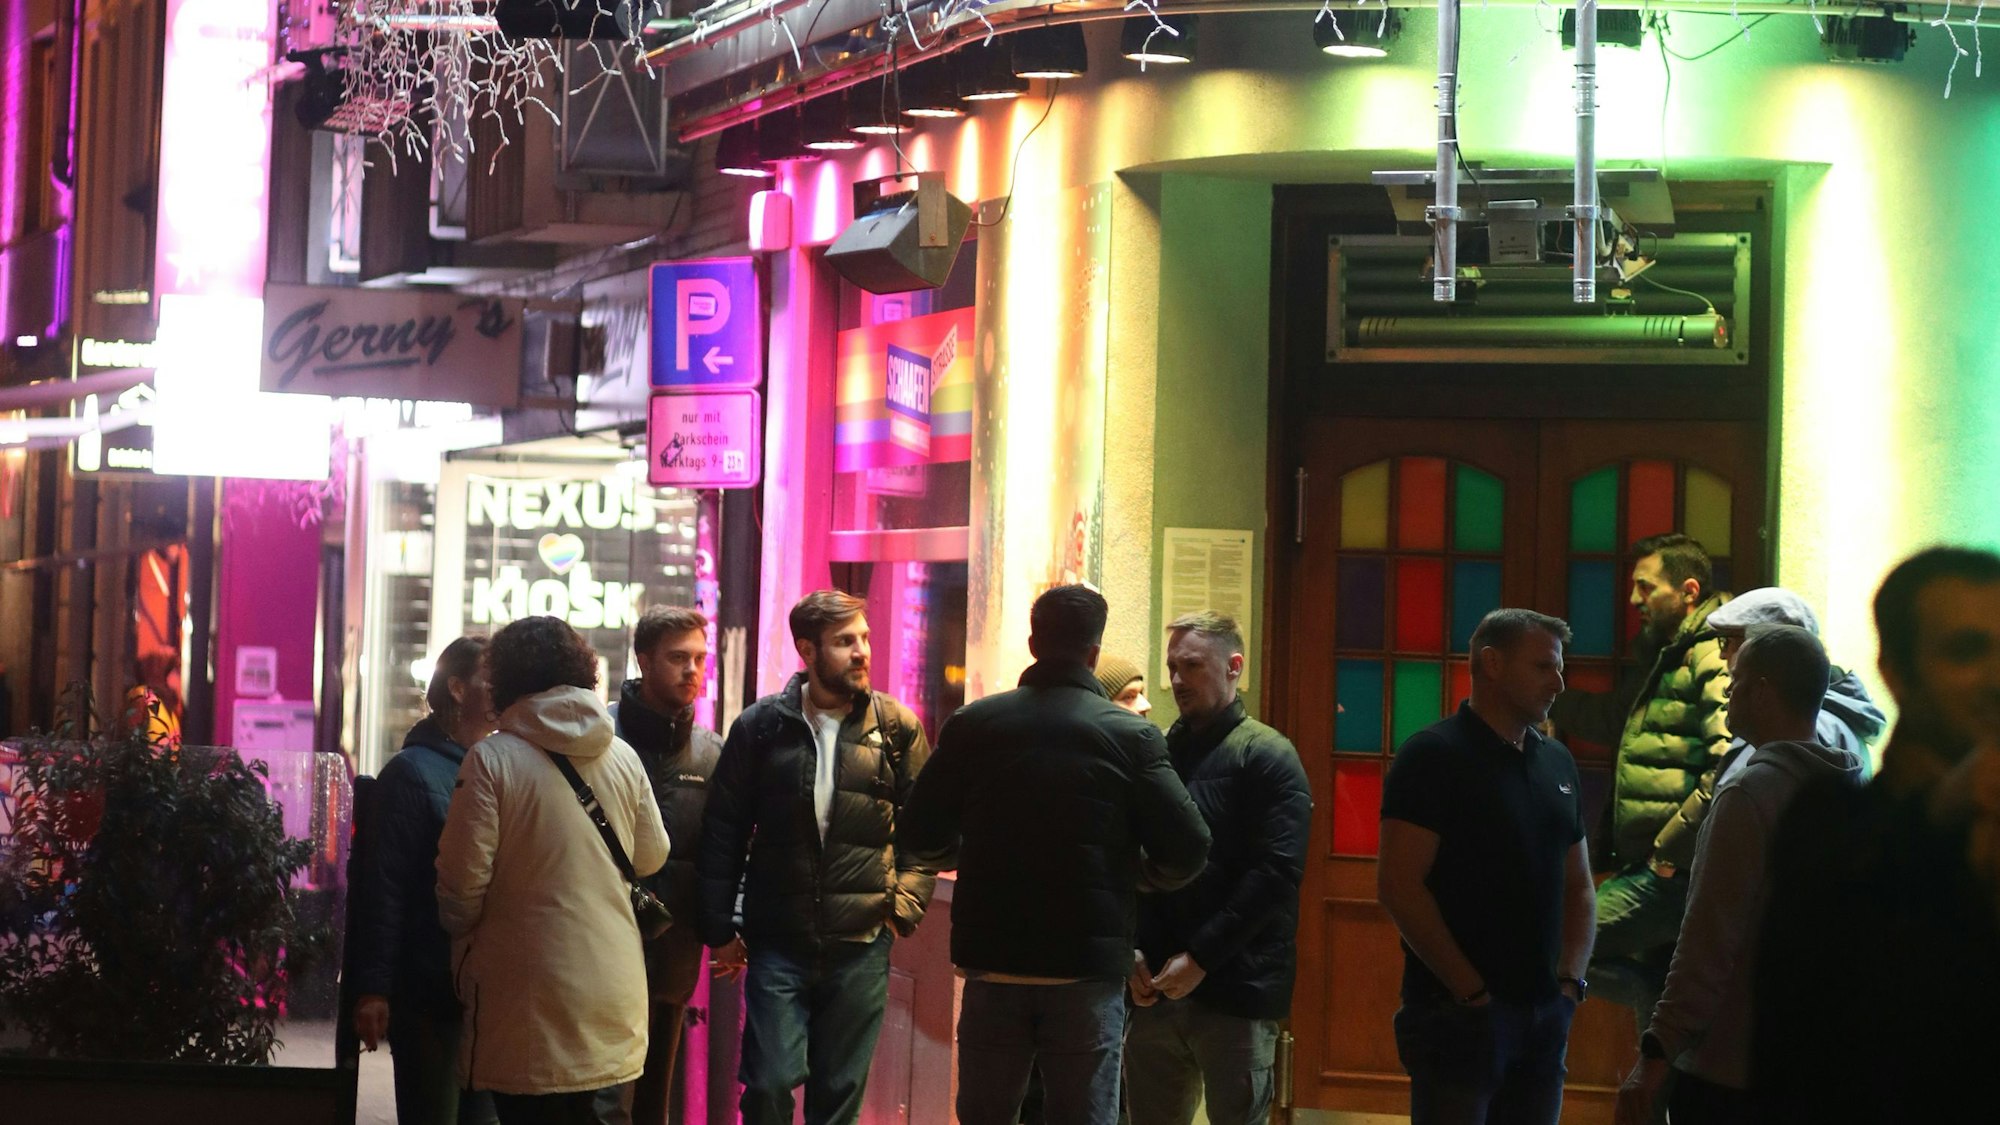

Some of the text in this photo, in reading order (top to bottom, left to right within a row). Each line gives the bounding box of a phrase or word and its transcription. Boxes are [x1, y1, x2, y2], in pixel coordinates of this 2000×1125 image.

[268, 300, 512, 388] Gerny's
[676, 278, 731, 371] P
[887, 354, 931, 415] SCHAAFEN
[674, 432, 729, 446] Parkschein
[682, 411, 721, 424] nur mit
[467, 477, 656, 530] NEXUS
